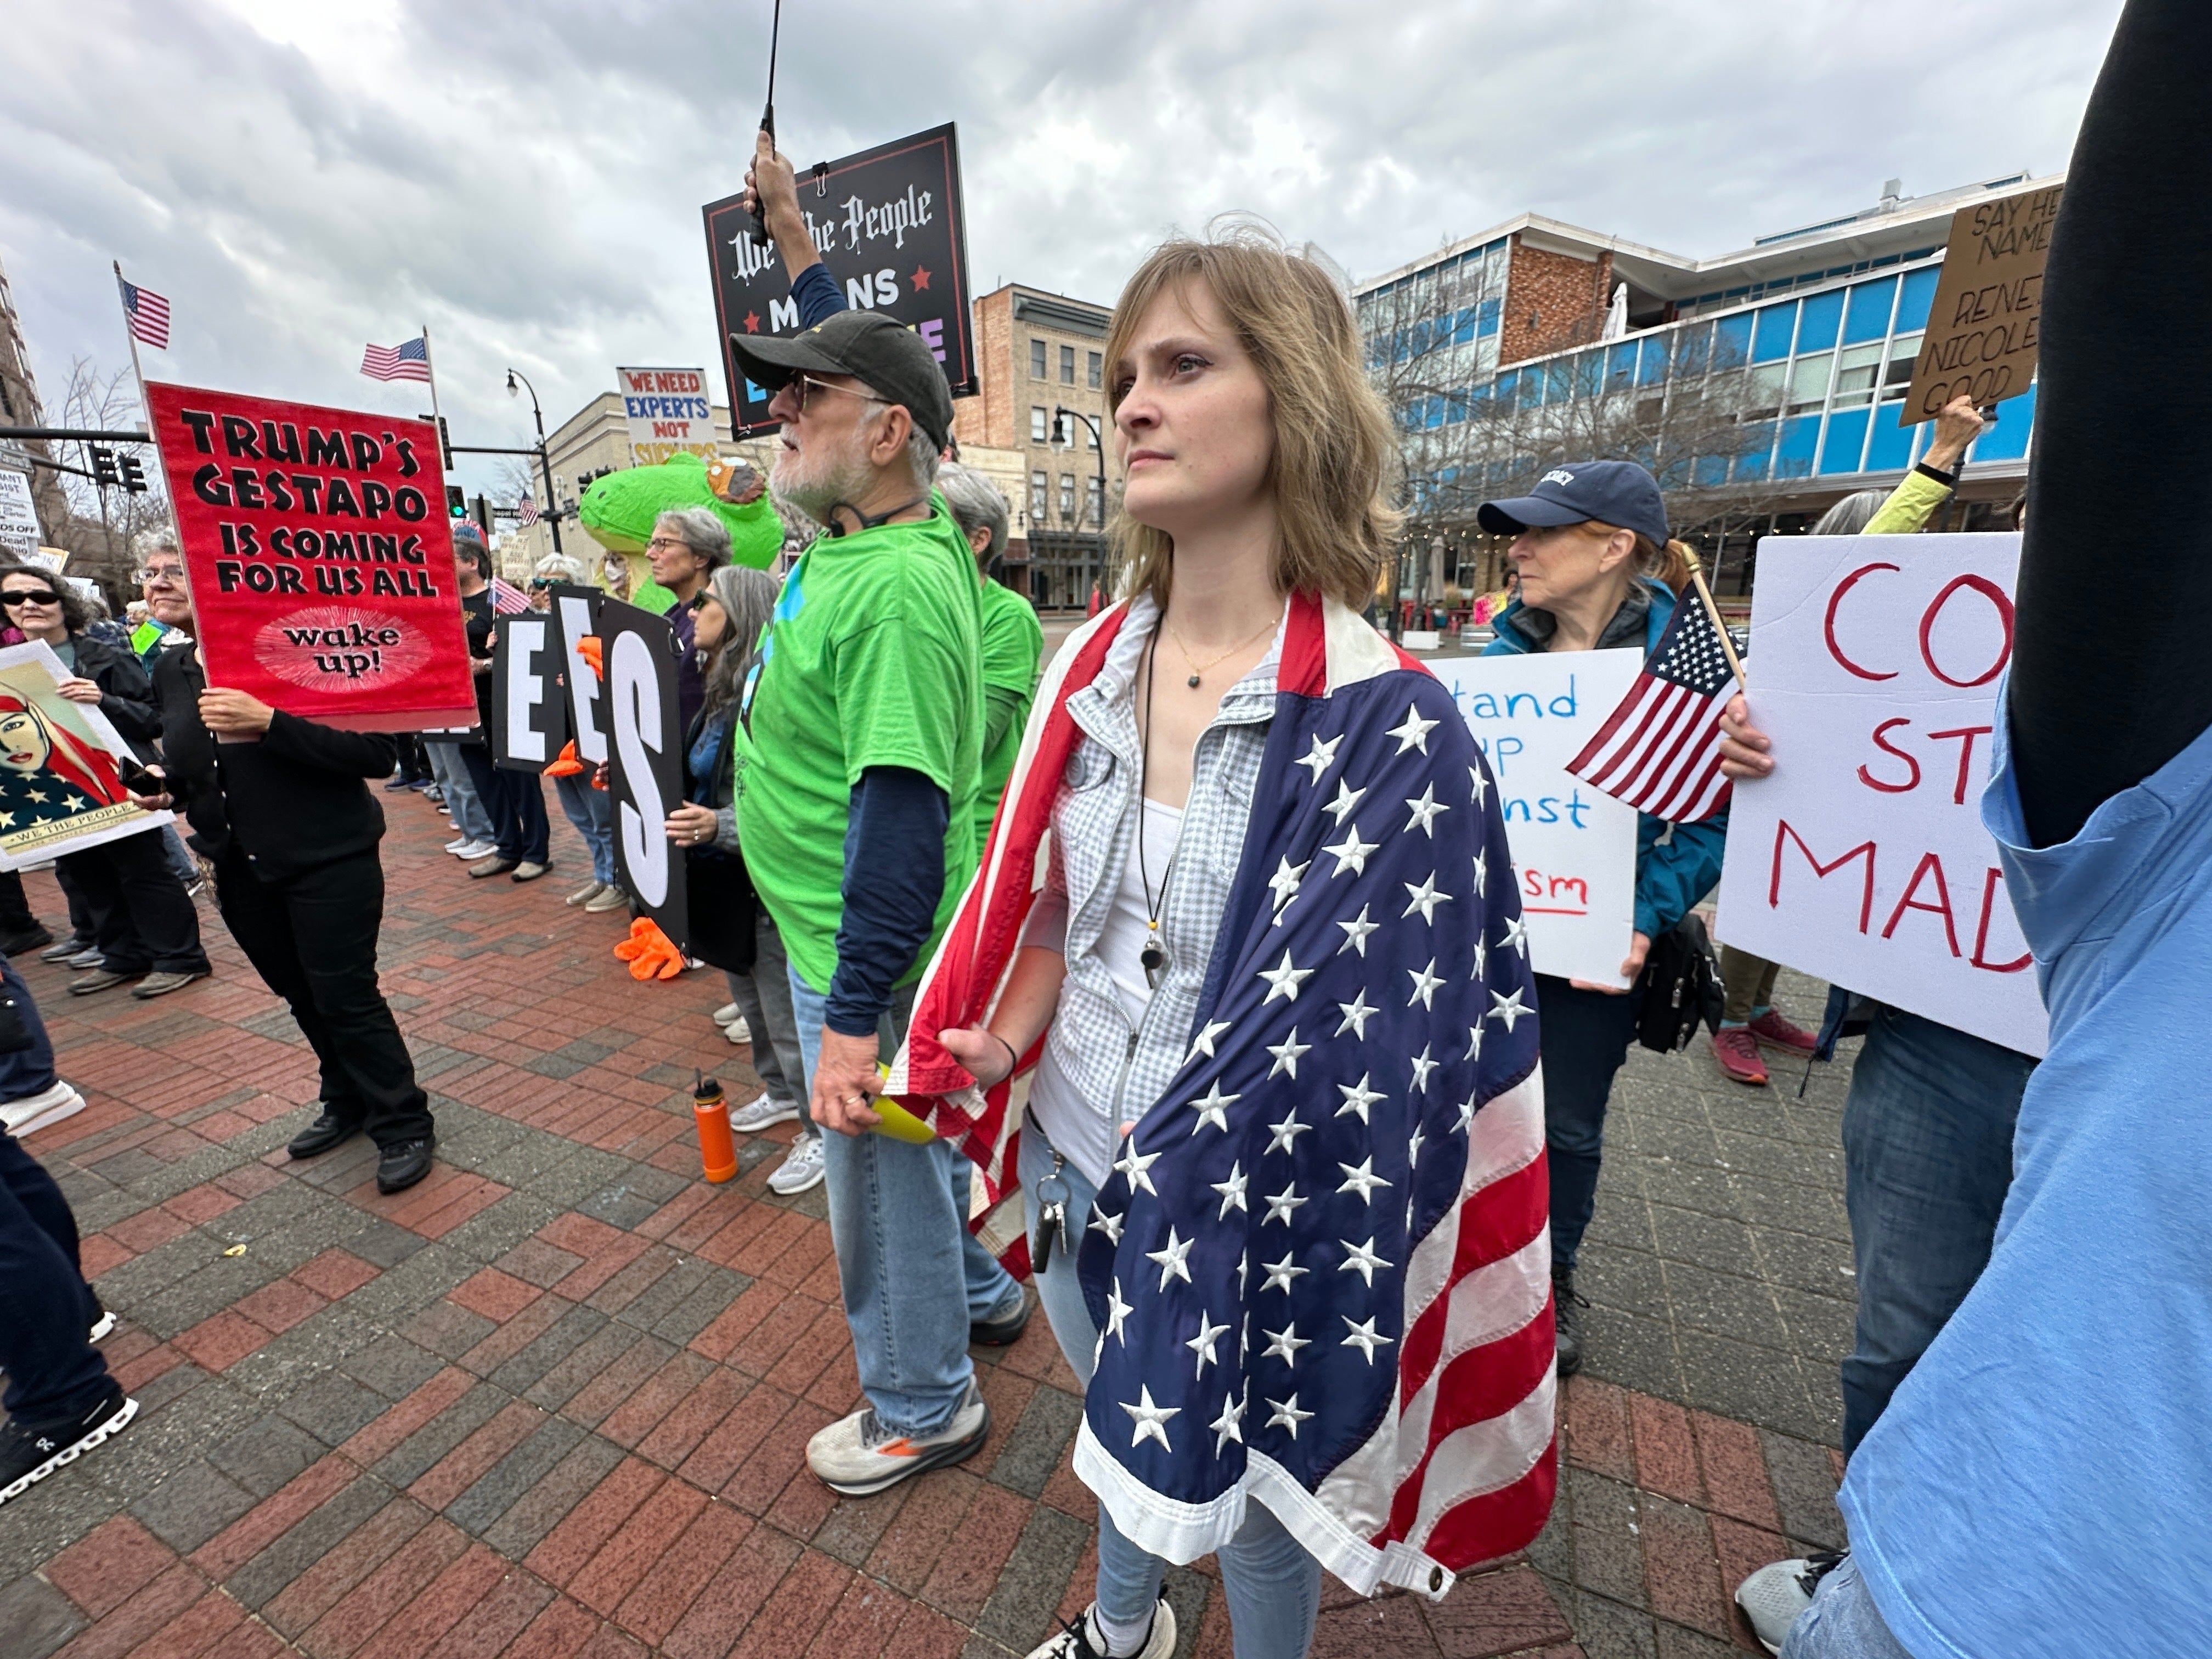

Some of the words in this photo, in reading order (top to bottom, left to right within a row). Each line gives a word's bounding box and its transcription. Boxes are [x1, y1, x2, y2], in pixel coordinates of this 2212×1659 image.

[800, 210, 836, 253] he
[840, 184, 932, 254] People
[1972, 196, 2025, 236] SAY
[2029, 188, 2063, 221] HE
[1978, 220, 2053, 264] NAME
[769, 268, 899, 332] MNS
[1953, 275, 2044, 328] RENE
[1923, 317, 2039, 375] NICOLE
[626, 372, 654, 393] WE
[654, 371, 700, 393] NEED
[1923, 365, 2013, 415] GOOD
[624, 396, 709, 419] EXPERTS
[652, 421, 691, 438] NOT
[181, 408, 420, 477] TRUMP'S
[193, 463, 428, 522] GESTAPO
[220, 522, 260, 556] IS
[270, 527, 426, 565] COMING
[216, 560, 307, 595] FOR
[314, 565, 364, 596] US
[373, 568, 438, 597] ALL
[283, 620, 400, 647] wake
[313, 650, 382, 678] up!
[507, 620, 545, 762] E
[1452, 673, 1578, 719] tand
[611, 630, 668, 908] S
[1857, 718, 1993, 805] ST
[16, 829, 42, 842] WE
[44, 820, 75, 834] THE
[78, 804, 131, 825] PEOPLE
[1503, 789, 1591, 828] nst
[1513, 862, 1588, 904] sm
[1769, 819, 2033, 972] MAD
